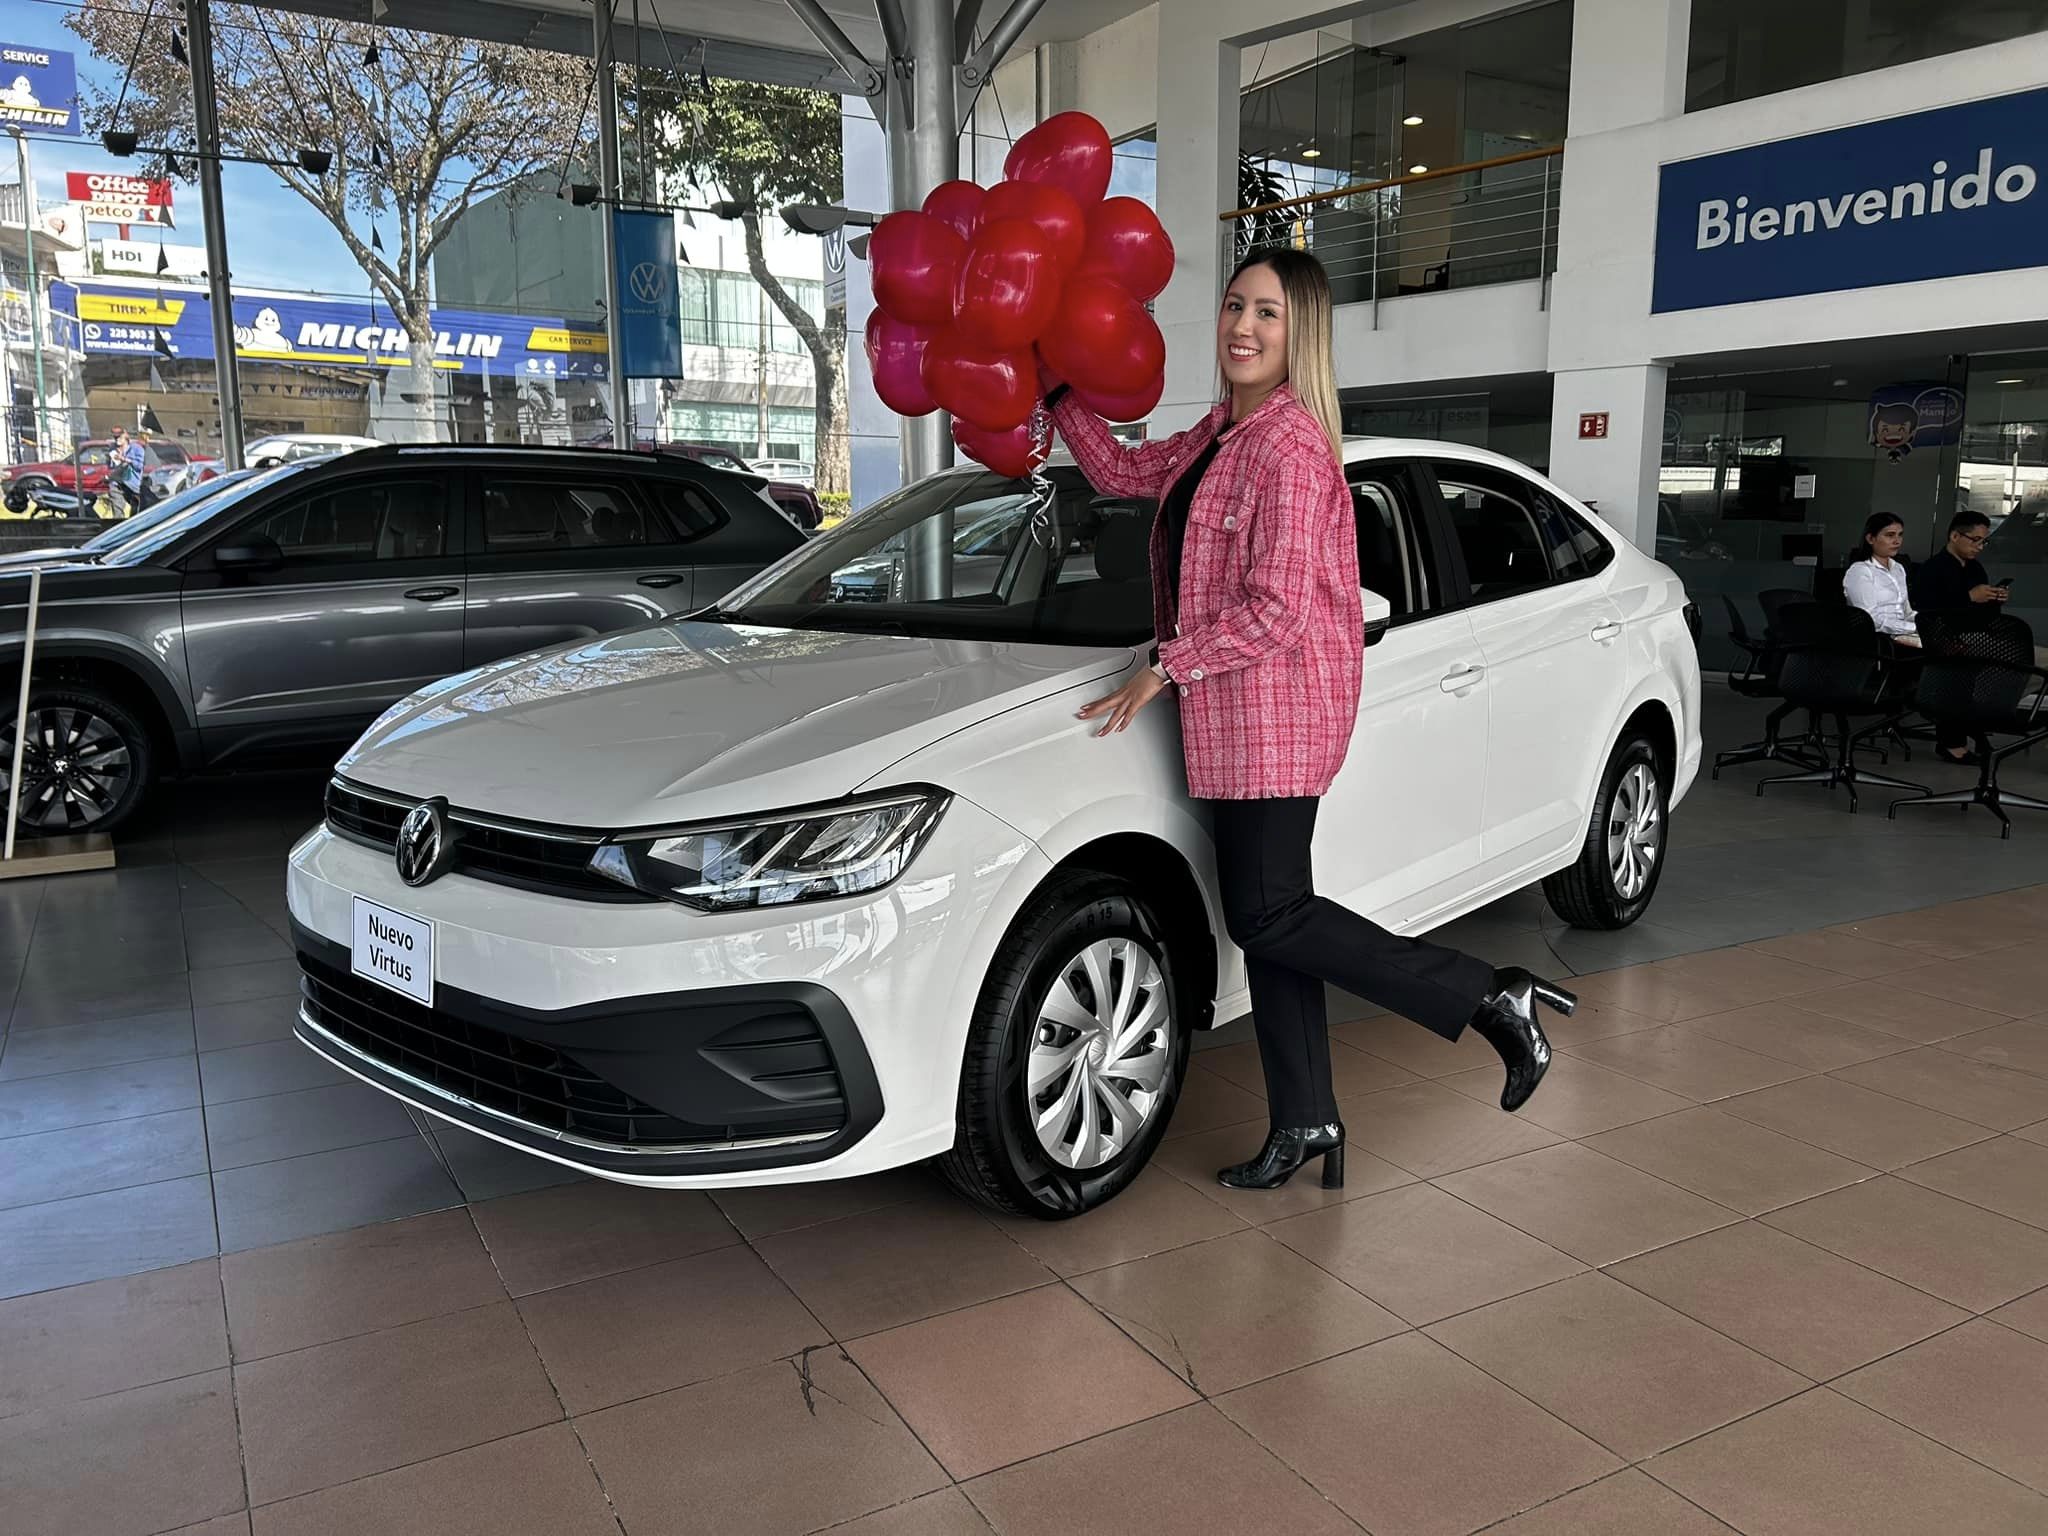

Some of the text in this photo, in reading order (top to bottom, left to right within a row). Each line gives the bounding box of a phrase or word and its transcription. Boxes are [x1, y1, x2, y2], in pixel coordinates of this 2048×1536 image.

[3, 50, 49, 65] SERVICE
[87, 175, 149, 194] Office
[1697, 147, 2037, 250] Bienvenido
[112, 249, 142, 262] HDI
[109, 303, 147, 315] TIREX
[297, 322, 502, 357] MICHLIN
[548, 335, 563, 345] CAR
[369, 913, 414, 951] Nuevo
[369, 944, 412, 982] Virtus
